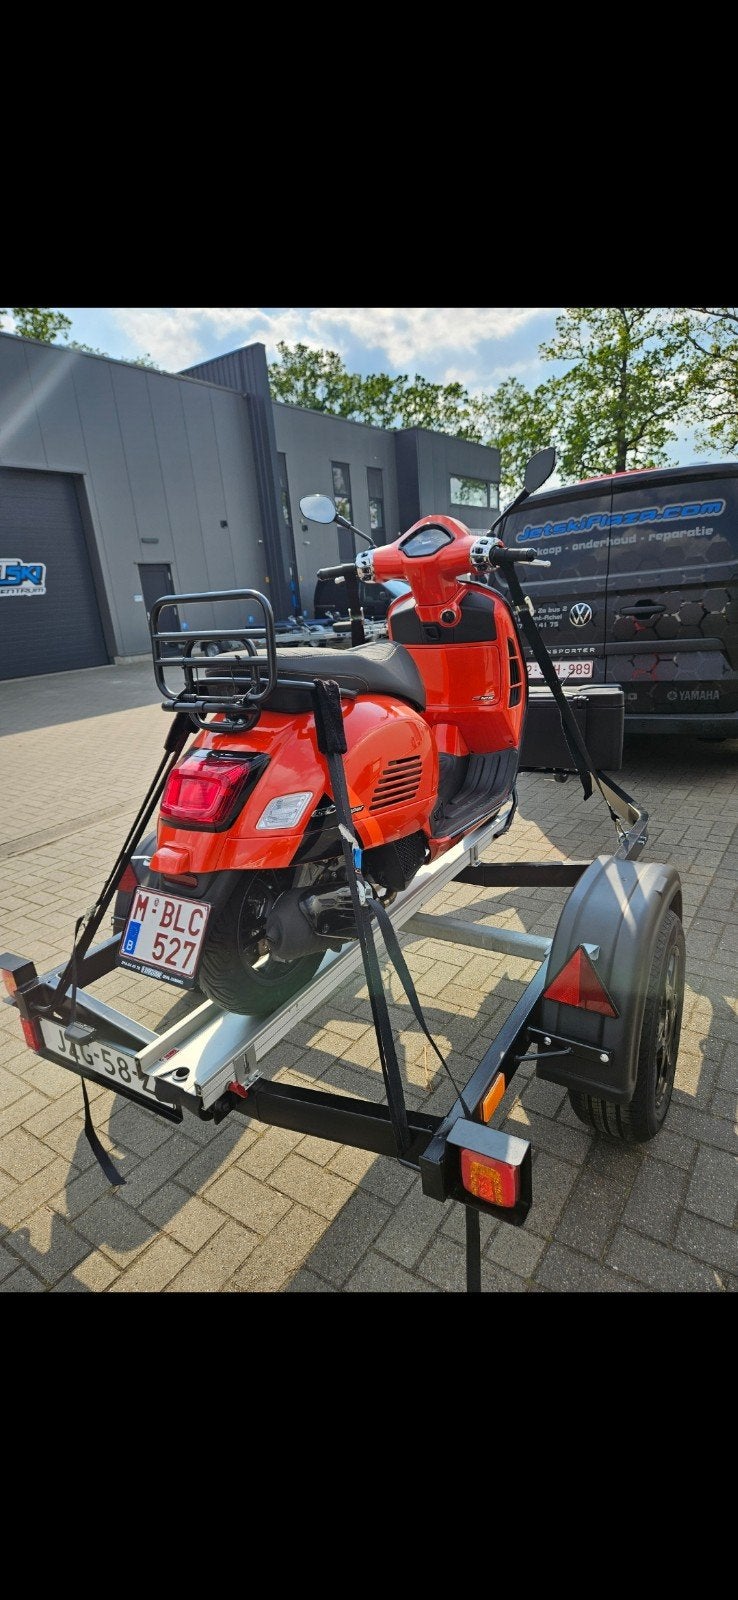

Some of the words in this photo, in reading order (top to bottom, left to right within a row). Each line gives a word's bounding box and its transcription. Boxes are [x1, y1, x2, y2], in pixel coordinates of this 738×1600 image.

[517, 500, 724, 542] JetskiPlaza.com
[534, 546, 562, 557] koop
[572, 533, 637, 551] onderhoud
[648, 526, 713, 542] reparatie
[529, 647, 596, 655] TNSPORTER
[526, 663, 591, 676] 2-H-989
[680, 690, 720, 700] YAMAHA
[126, 940, 134, 951] B
[151, 932, 197, 970] 527
